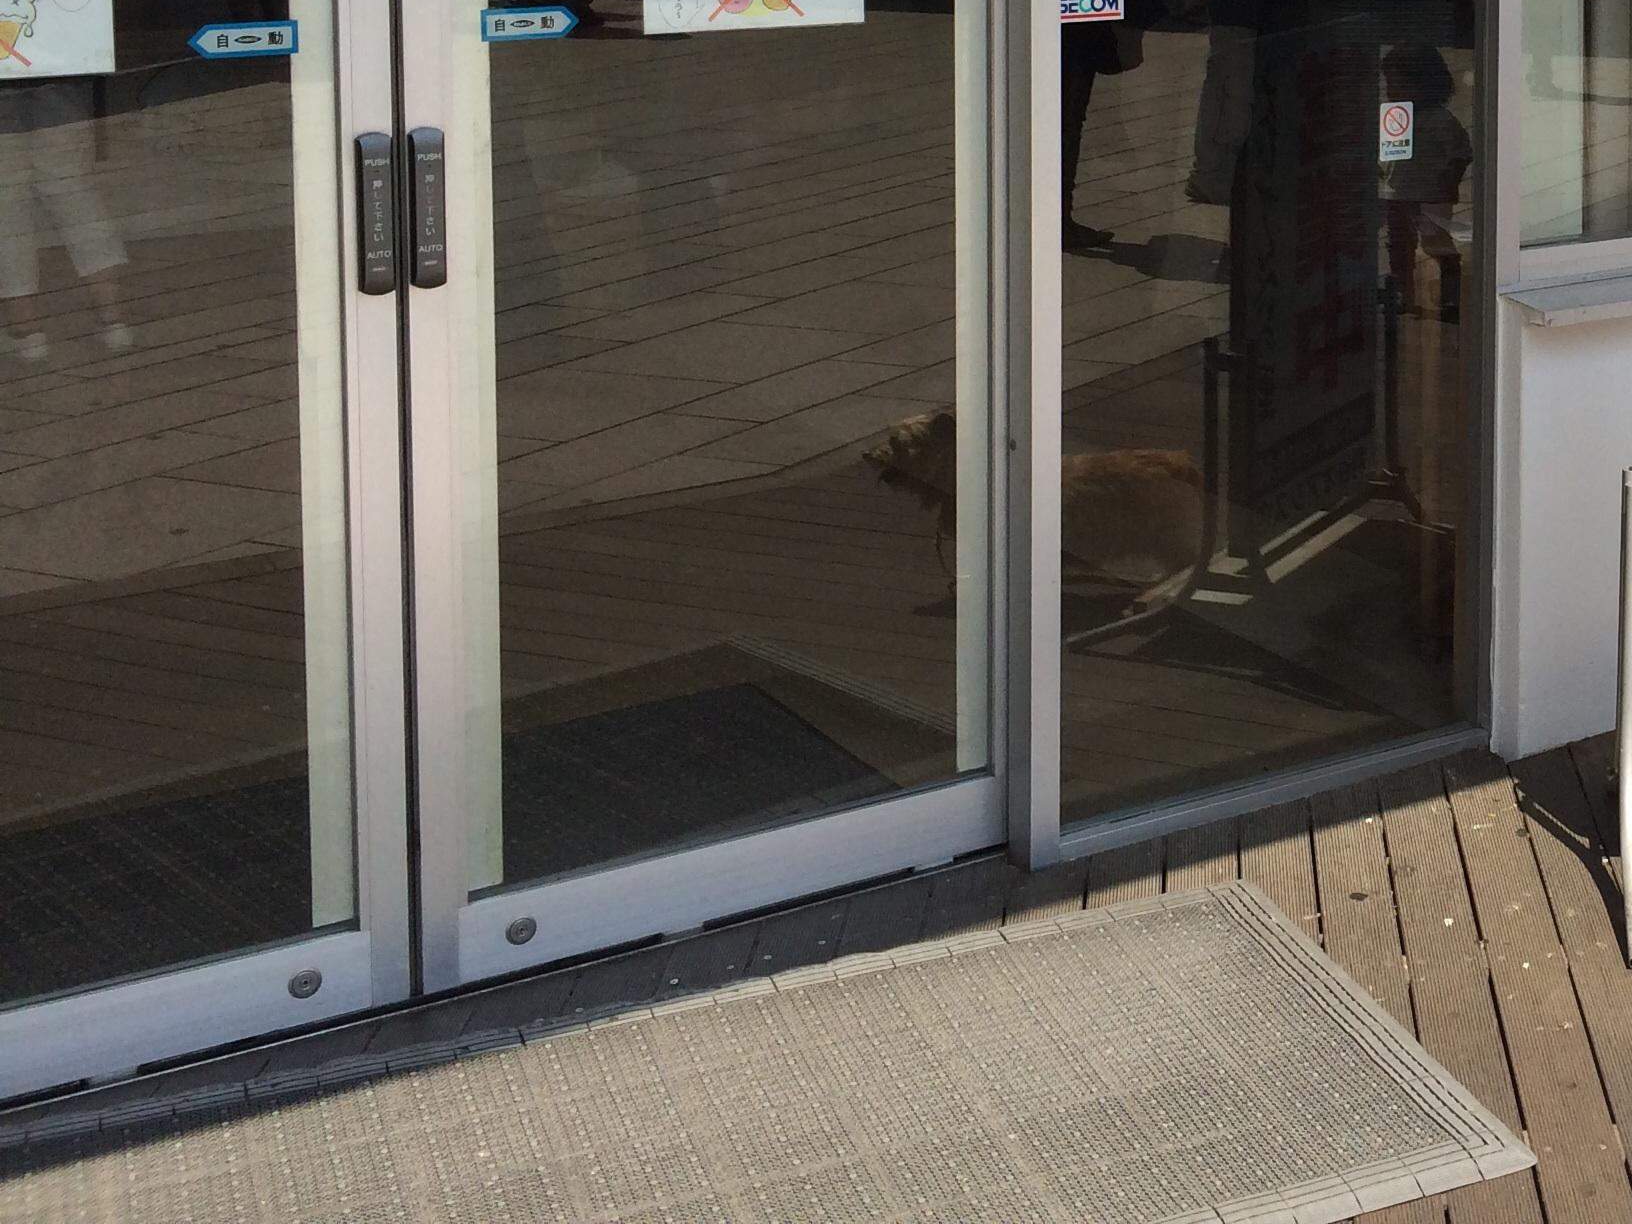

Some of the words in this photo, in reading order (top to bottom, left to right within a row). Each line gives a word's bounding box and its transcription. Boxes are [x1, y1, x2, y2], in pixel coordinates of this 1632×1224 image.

[495, 16, 554, 32] 自動
[217, 32, 284, 49] 自動
[417, 153, 442, 162] PUSH
[364, 158, 389, 167] PUSH
[424, 174, 436, 236] 押し下さい
[418, 244, 443, 253] AUTO
[367, 250, 392, 259] AUTO
